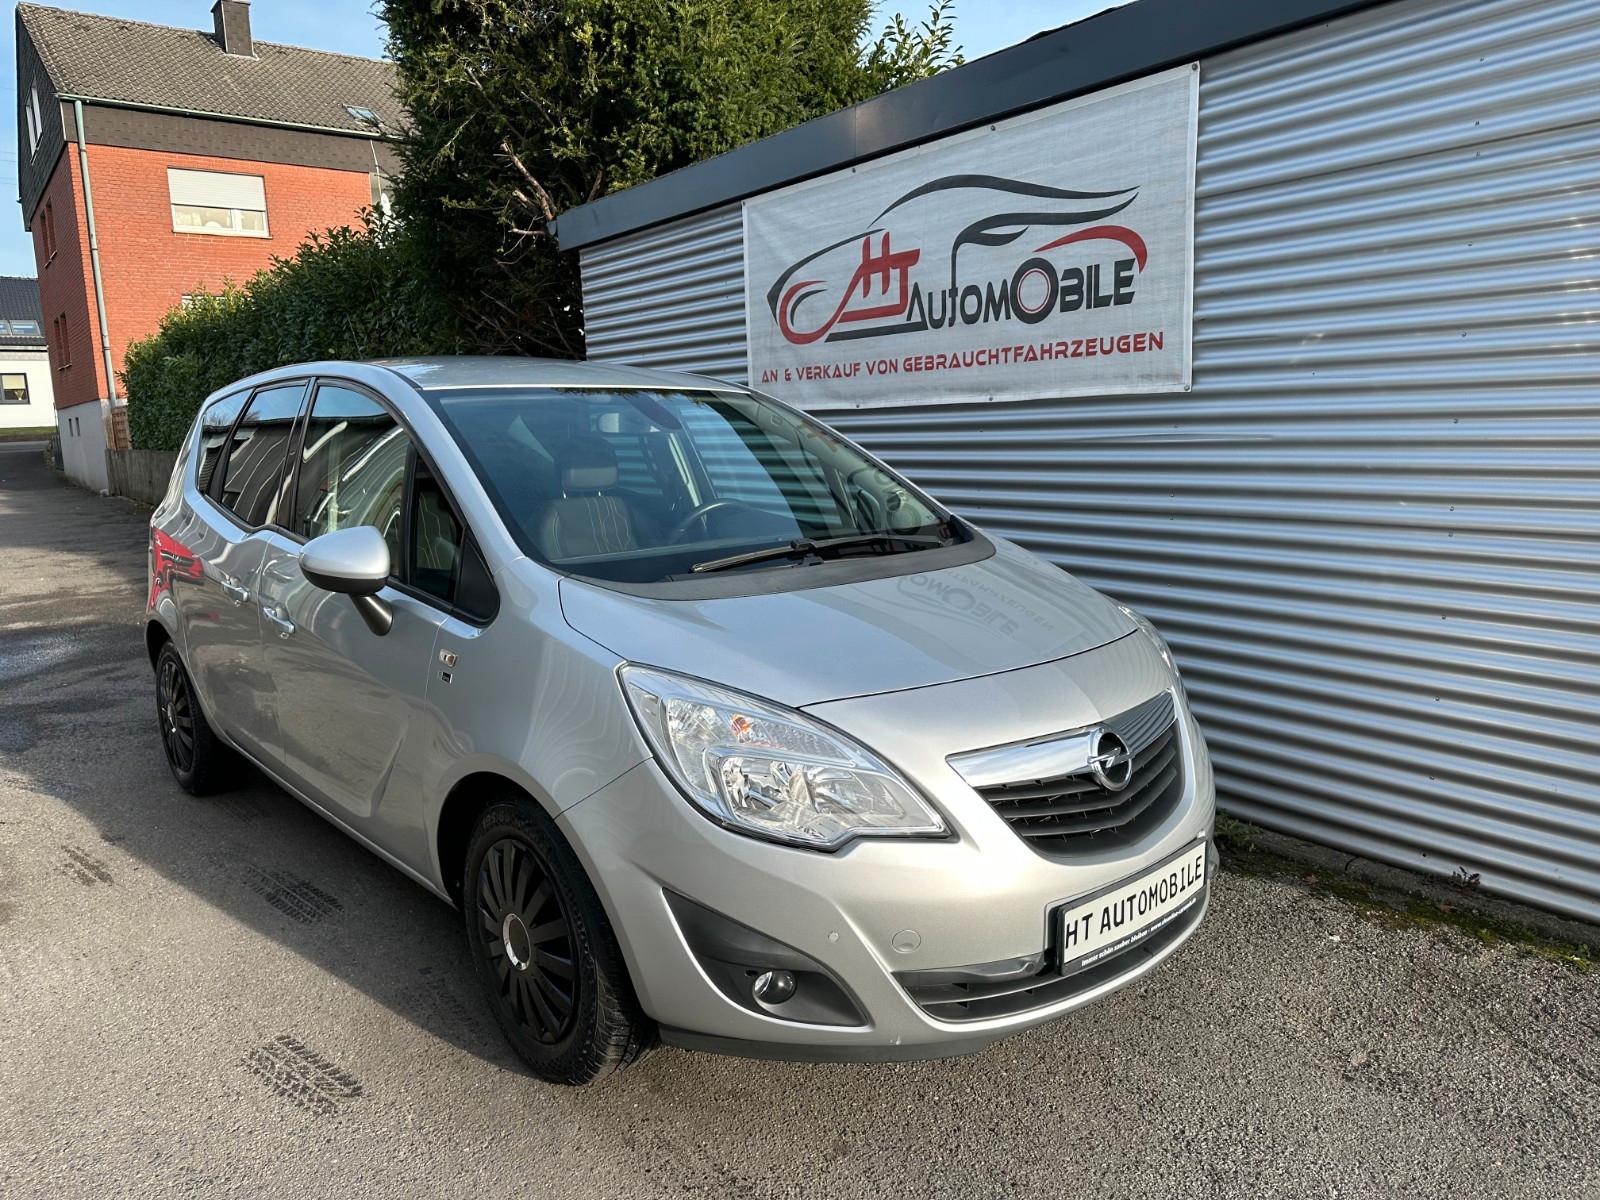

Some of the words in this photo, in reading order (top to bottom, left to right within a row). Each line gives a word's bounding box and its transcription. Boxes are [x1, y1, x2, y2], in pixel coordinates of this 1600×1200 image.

[905, 257, 1136, 330] AUTOMOBILE
[761, 369, 778, 384] AN
[784, 368, 792, 382] &
[796, 362, 861, 381] VERKAUF
[865, 358, 898, 376] VON
[903, 331, 1164, 373] GEBRAUCHTFAHRZEUGEN
[1065, 912, 1093, 949] HT
[1100, 855, 1202, 934] AUTOMOBILE
